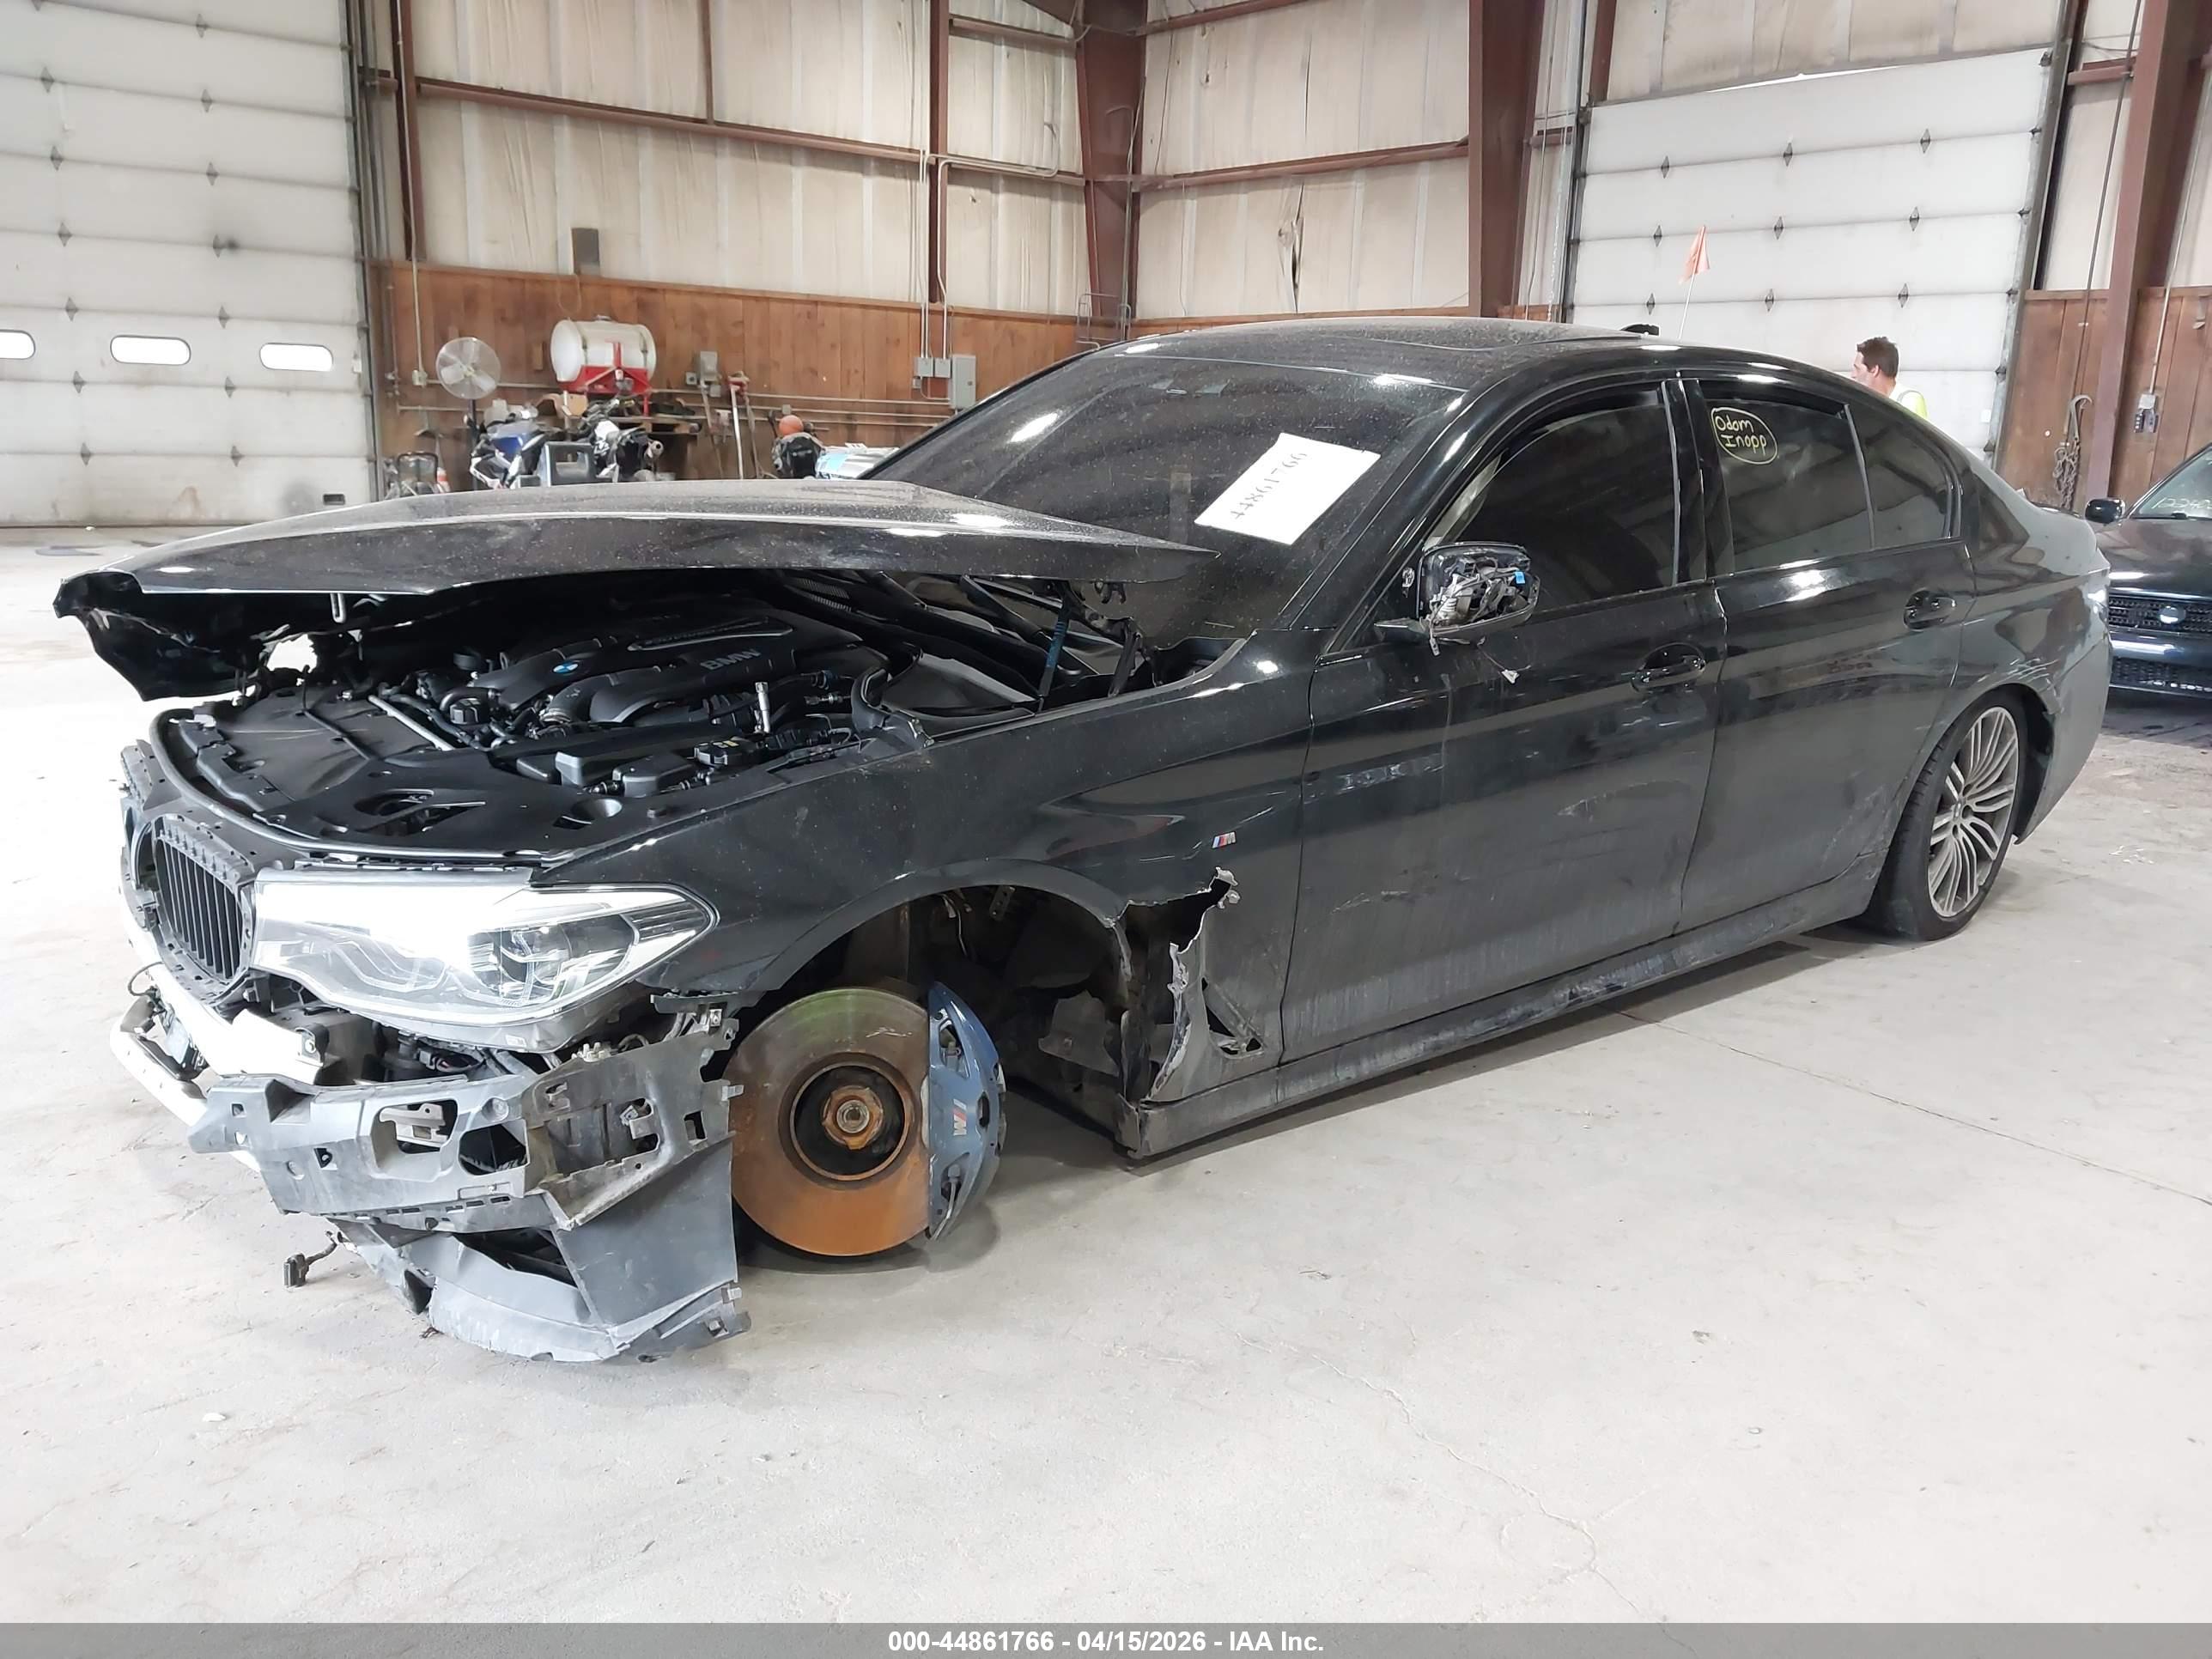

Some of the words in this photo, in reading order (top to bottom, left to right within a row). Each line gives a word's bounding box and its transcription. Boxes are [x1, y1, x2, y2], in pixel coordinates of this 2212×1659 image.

[1715, 414, 1754, 434] Odom
[1721, 434, 1767, 456] Inopp
[700, 648, 761, 670] BMW
